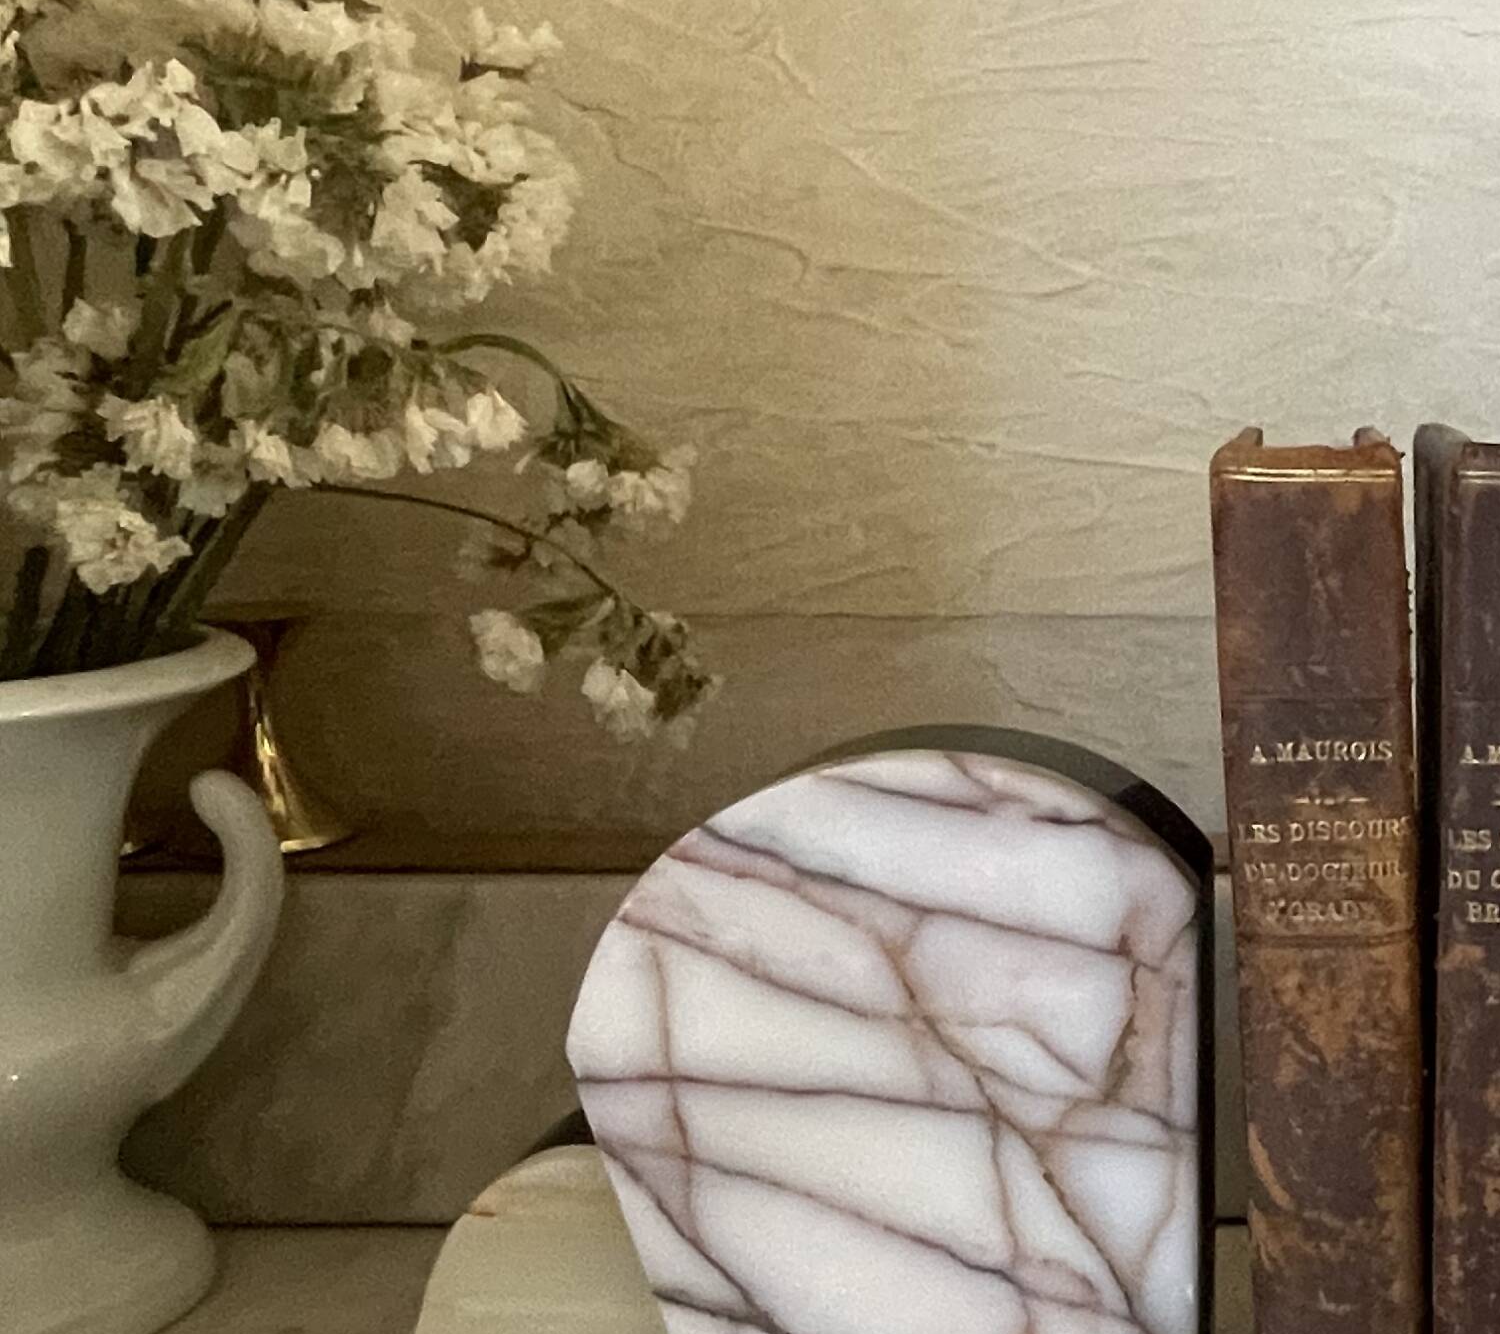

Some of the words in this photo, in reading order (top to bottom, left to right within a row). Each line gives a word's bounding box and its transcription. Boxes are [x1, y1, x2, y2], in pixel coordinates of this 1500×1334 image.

[1275, 739, 1393, 763] MAUROIS
[1237, 822, 1281, 844] LES
[1448, 829, 1492, 851] LES
[1447, 869, 1482, 890] DU
